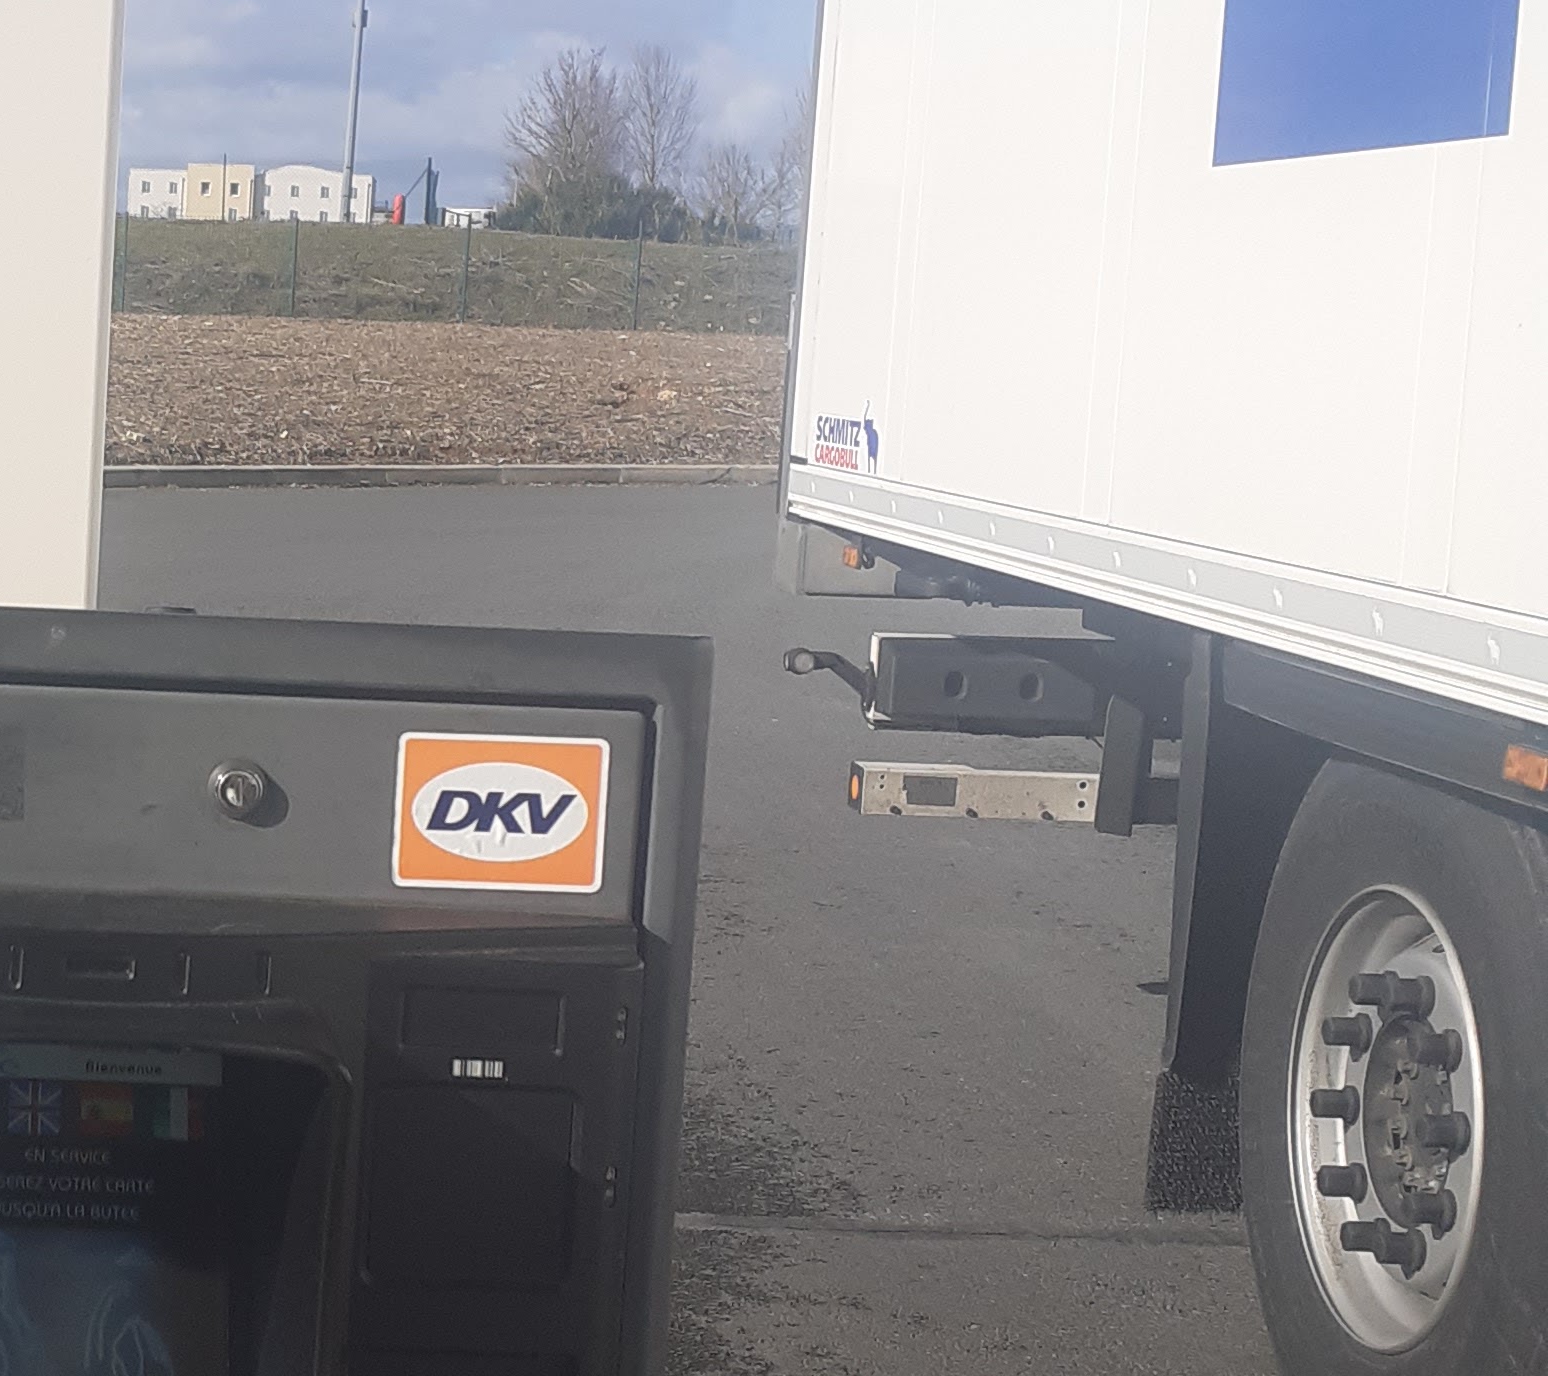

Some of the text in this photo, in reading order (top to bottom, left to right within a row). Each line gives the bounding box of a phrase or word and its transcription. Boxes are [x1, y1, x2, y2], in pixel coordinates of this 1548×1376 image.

[816, 415, 861, 447] SCHMITZ
[814, 443, 859, 470] CARGOBULL
[426, 790, 578, 835] DKV
[24, 1147, 112, 1165] EN SERVICE
[49, 1175, 101, 1192] VOTRE
[106, 1178, 155, 1195] CARTE
[66, 1202, 85, 1218] LA
